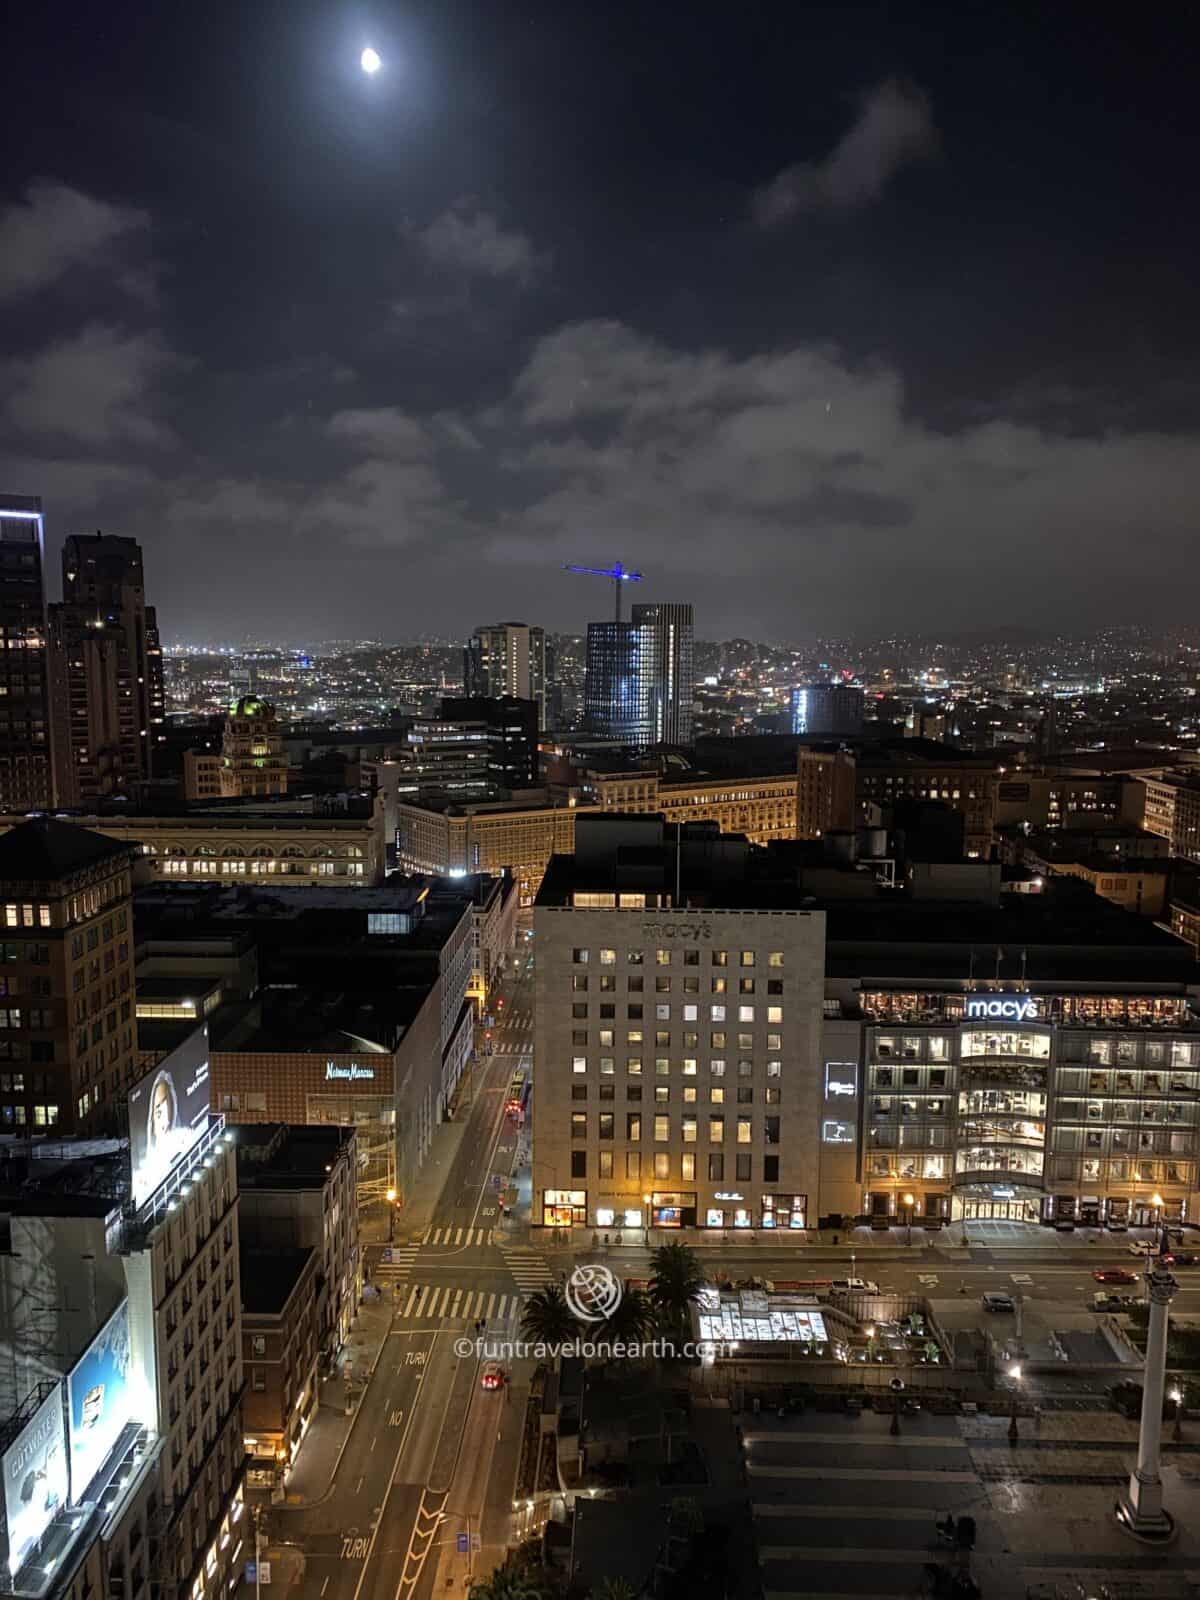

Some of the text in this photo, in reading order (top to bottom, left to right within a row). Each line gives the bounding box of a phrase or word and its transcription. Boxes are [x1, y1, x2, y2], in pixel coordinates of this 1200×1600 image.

[642, 920, 711, 941] macy's
[968, 997, 1038, 1021] macy's
[405, 1351, 428, 1366] TURN
[388, 1410, 403, 1426] NO
[340, 1537, 371, 1560] TURN
